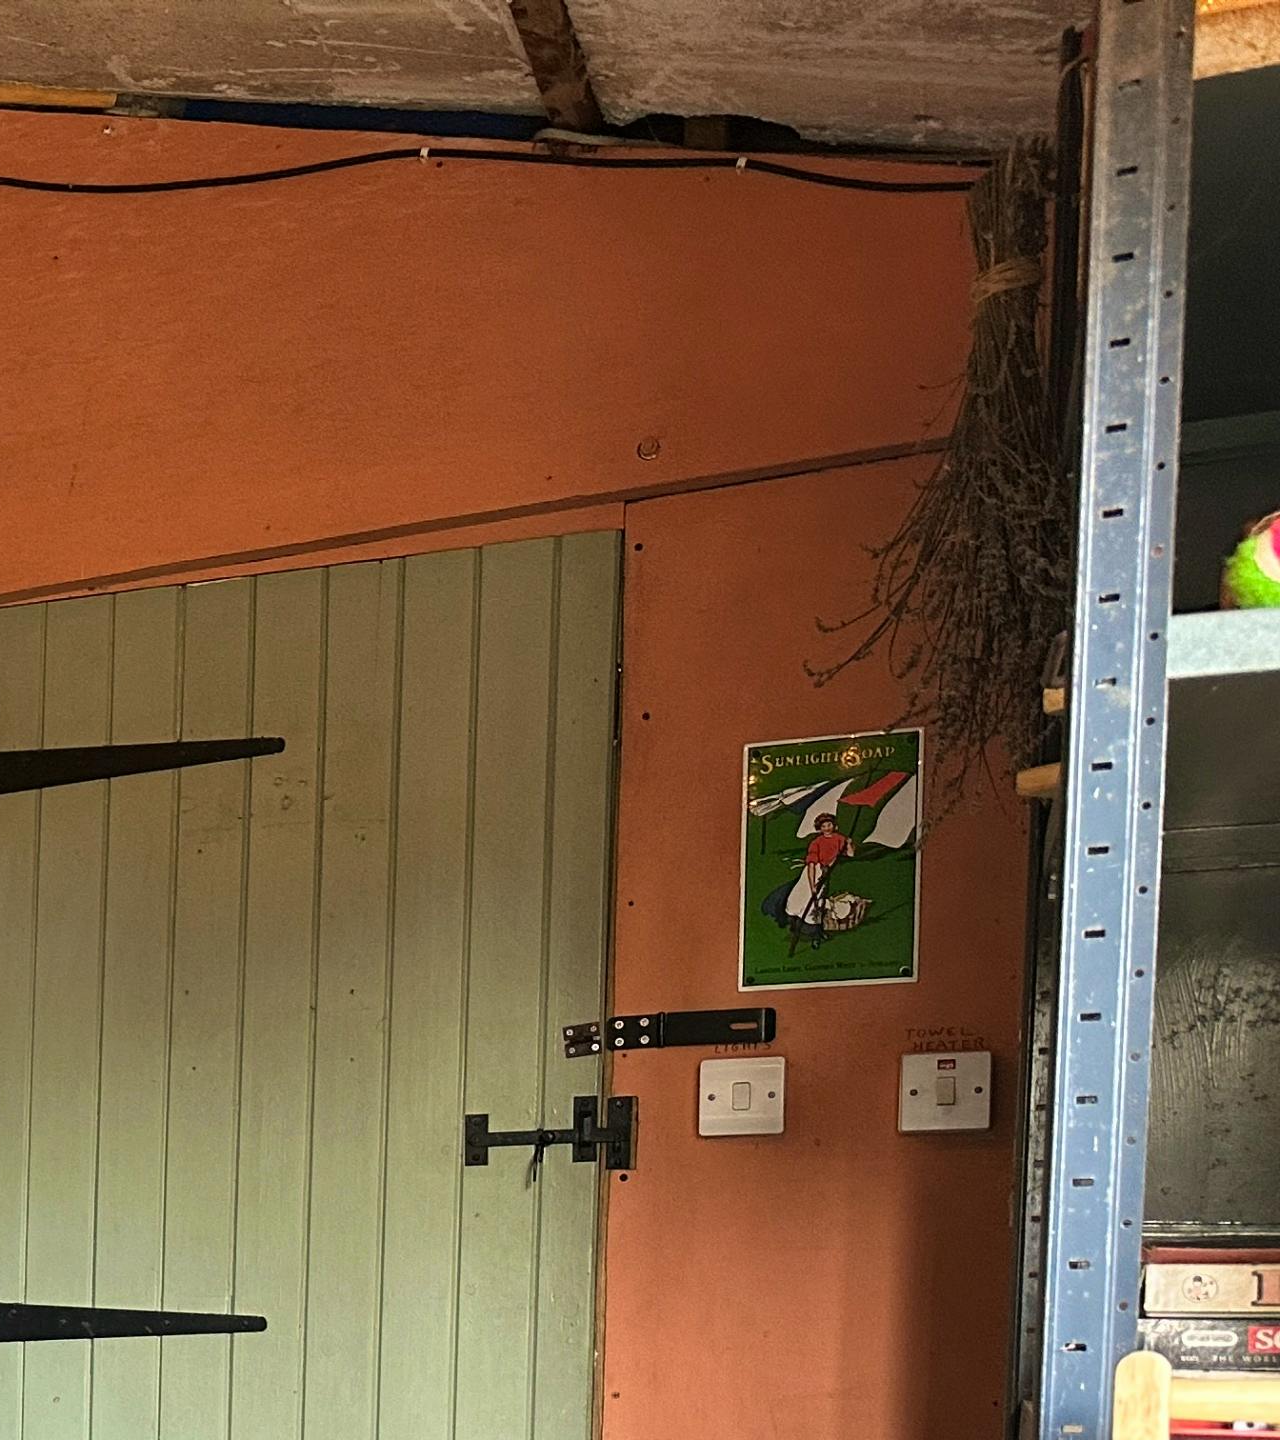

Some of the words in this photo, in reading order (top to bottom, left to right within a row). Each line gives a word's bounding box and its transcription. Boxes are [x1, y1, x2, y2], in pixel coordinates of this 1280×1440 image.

[759, 754, 839, 775] SUNLIGHT
[905, 1026, 976, 1039] TOWEL
[913, 1037, 985, 1051] HEATER
